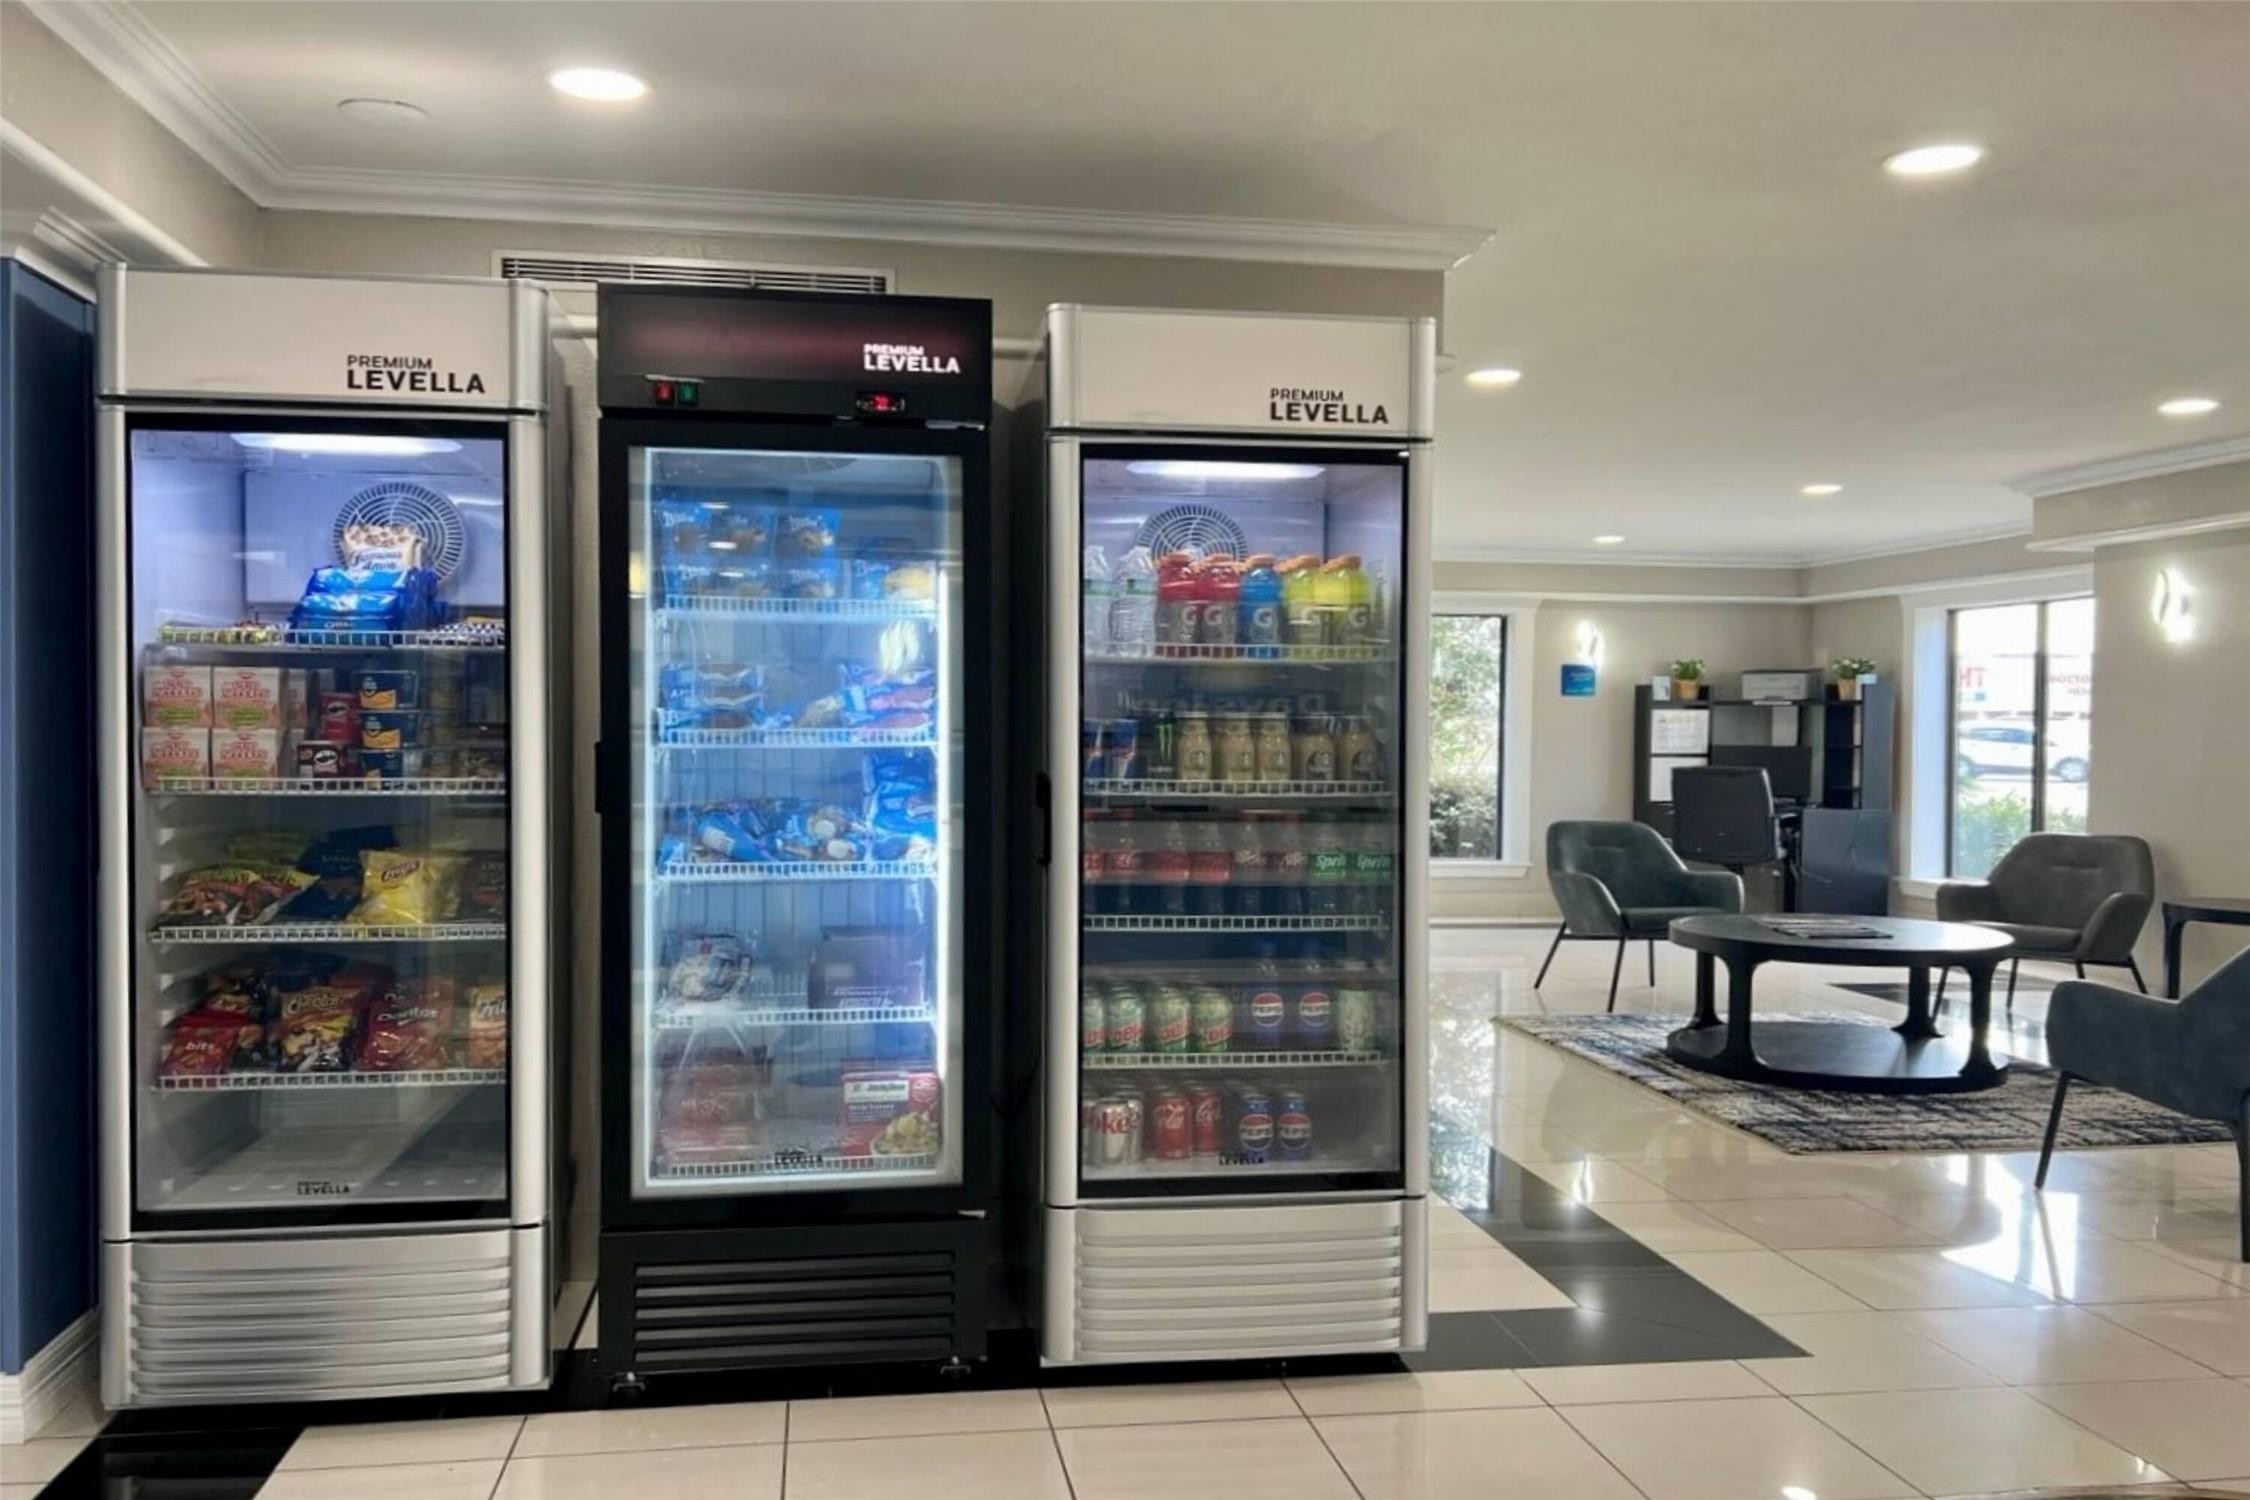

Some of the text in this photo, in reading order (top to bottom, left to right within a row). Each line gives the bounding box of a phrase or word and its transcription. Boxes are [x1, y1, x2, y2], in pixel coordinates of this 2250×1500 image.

[863, 343, 925, 356] PREMIUM
[347, 354, 433, 369] PREMIUM
[864, 354, 961, 375] LEVELLA
[347, 369, 486, 394] LEVELLA
[1270, 388, 1344, 402] PREMIUM
[1270, 401, 1389, 424] LEVELLA
[1204, 606, 1222, 625] G
[1253, 608, 1275, 628] G
[297, 1184, 351, 1196] LEVELLA
